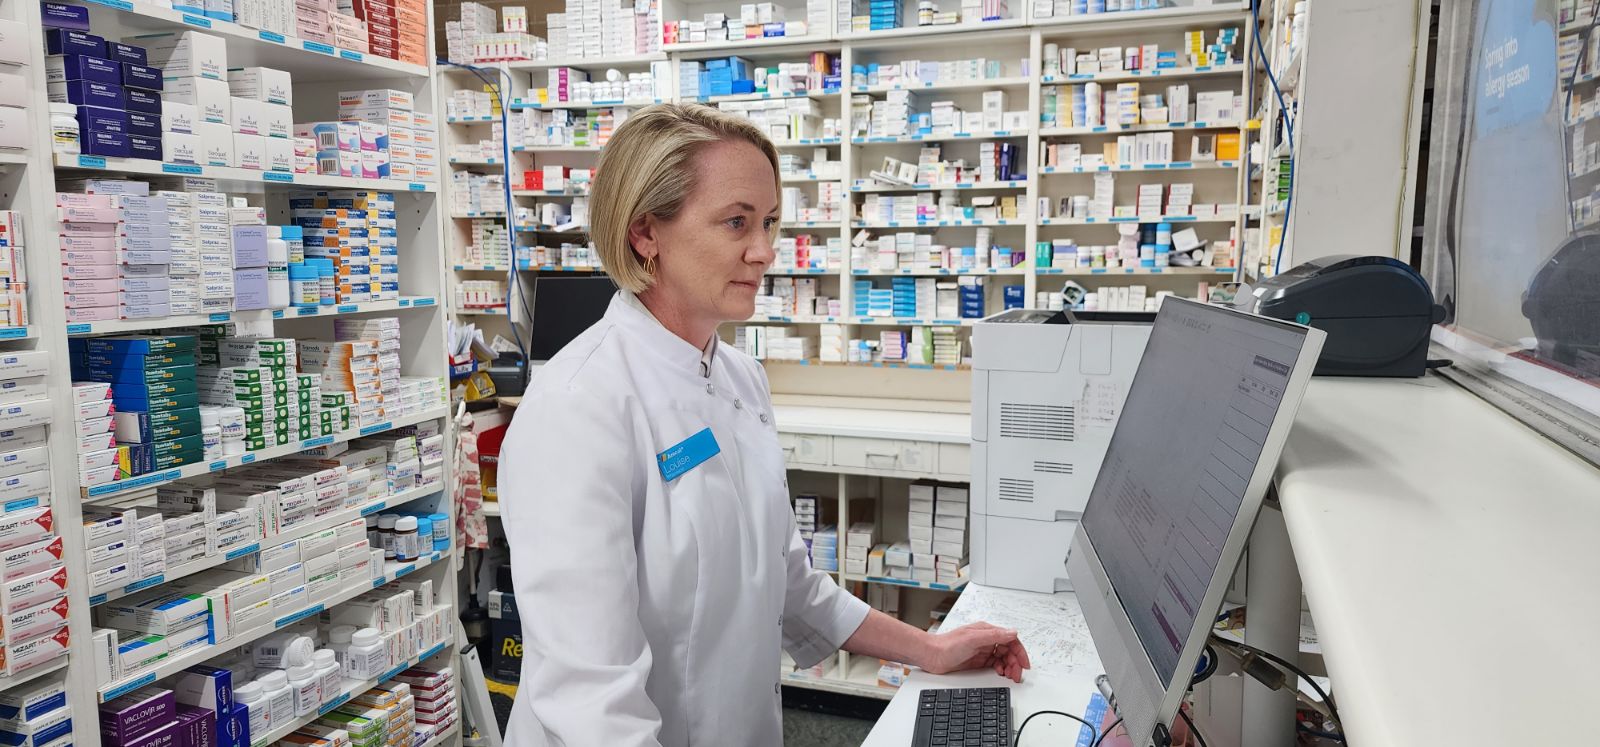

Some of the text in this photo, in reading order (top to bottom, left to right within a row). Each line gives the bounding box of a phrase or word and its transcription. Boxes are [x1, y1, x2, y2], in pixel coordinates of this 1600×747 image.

[1485, 36, 1518, 69] Spring into
[1485, 64, 1530, 98] allergy season
[664, 456, 690, 473] Louise
[20, 518, 34, 527] HCT
[5, 547, 45, 561] MIZART HCT
[10, 577, 49, 592] MIZART HCT
[12, 607, 51, 624] MIZART HCT
[12, 637, 51, 654] MIZART HCT
[124, 704, 166, 725] VACLOVIR 500
